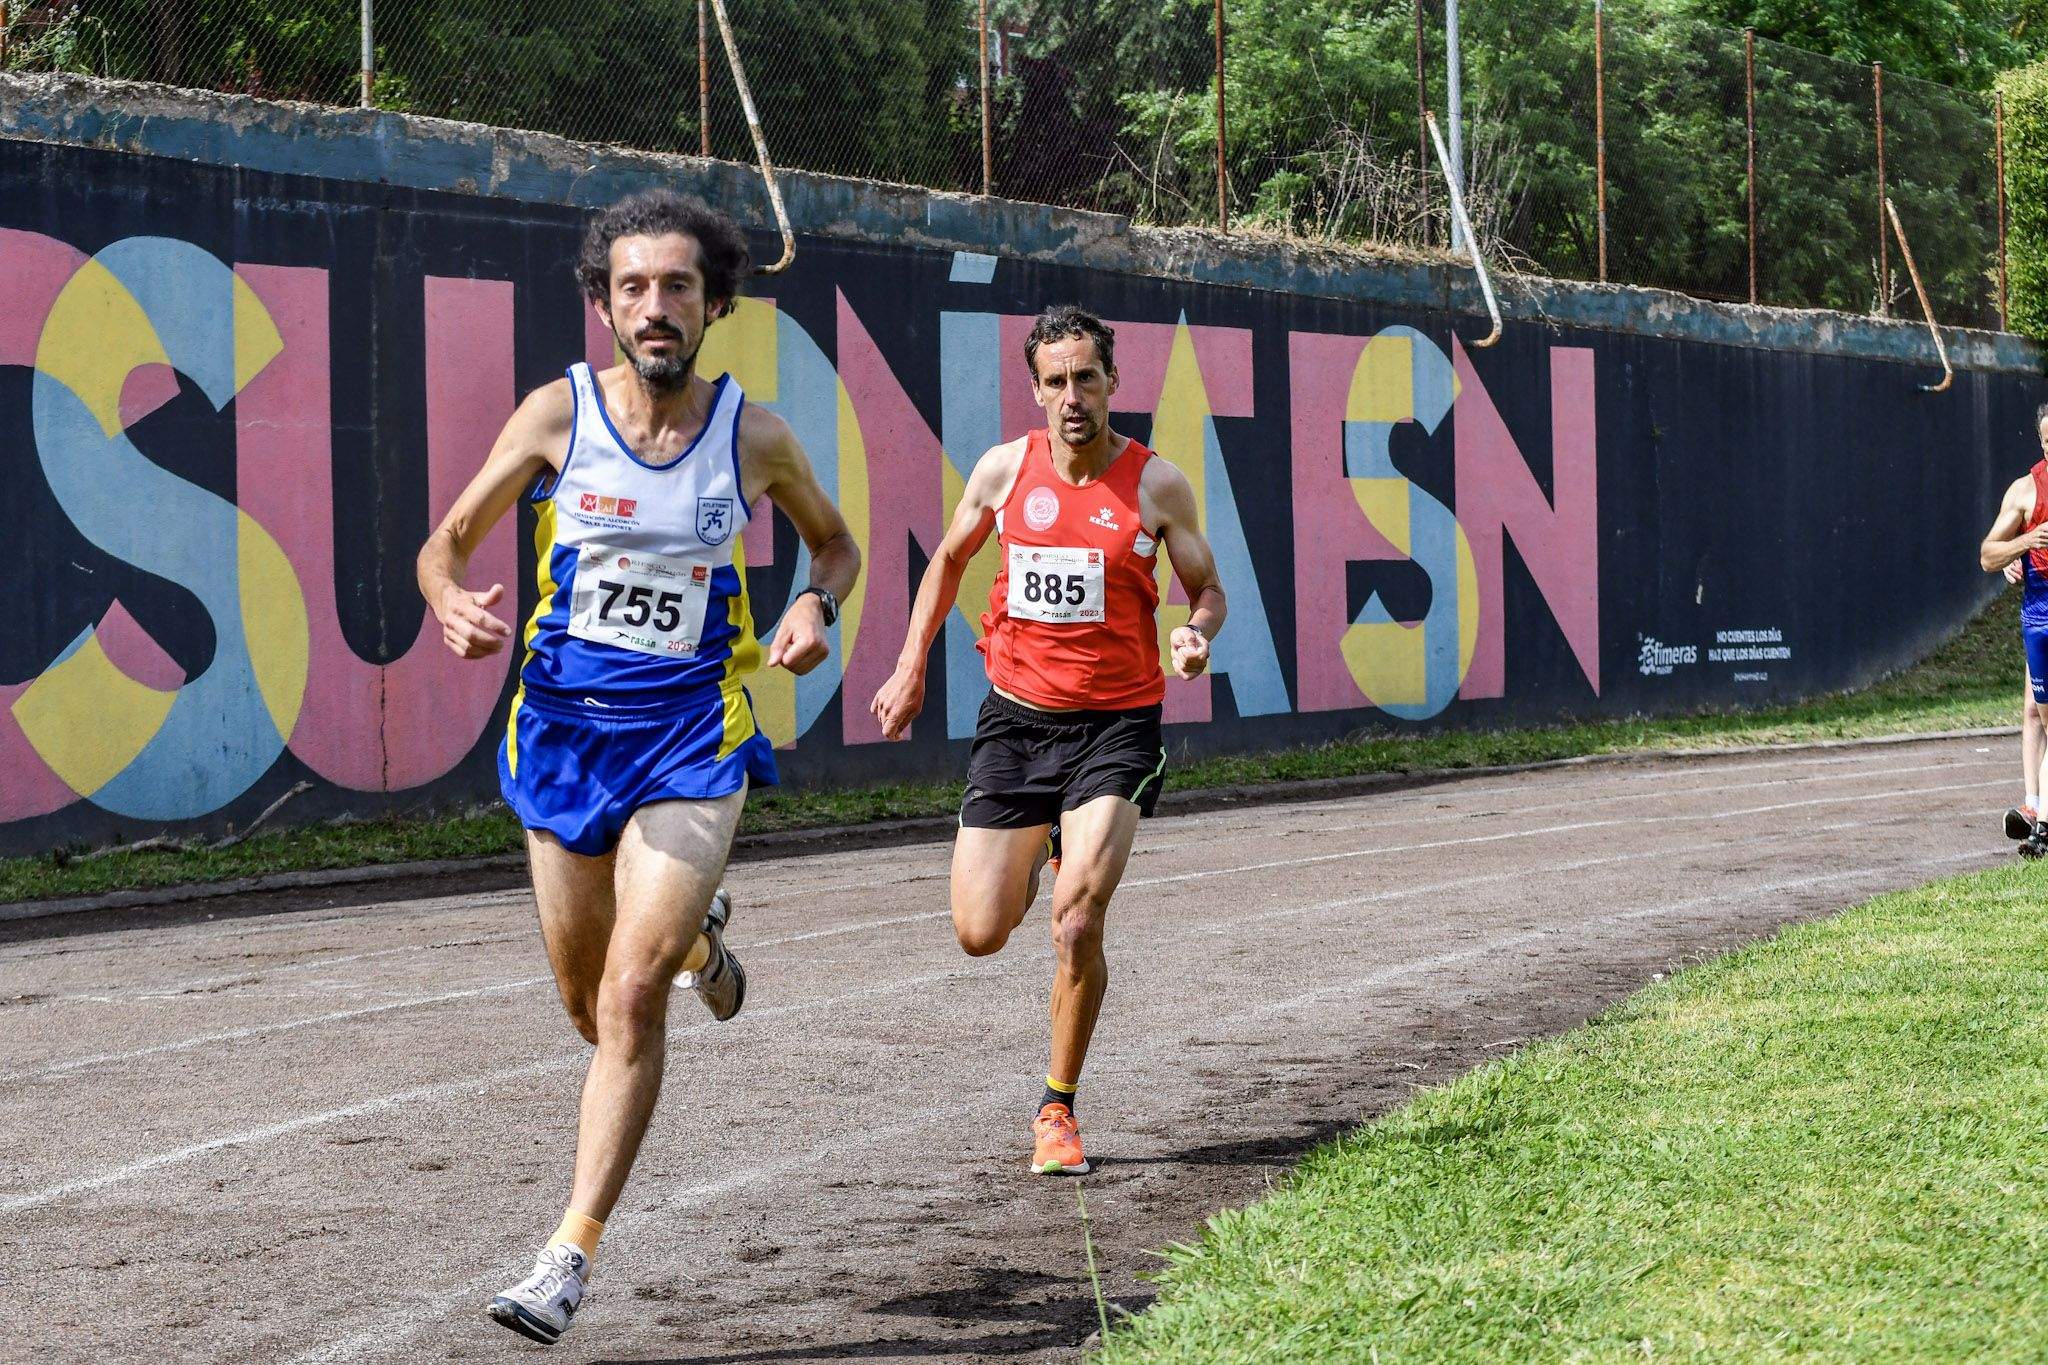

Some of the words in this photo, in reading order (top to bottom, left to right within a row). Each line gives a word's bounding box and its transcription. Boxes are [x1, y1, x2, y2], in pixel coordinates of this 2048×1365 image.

[1088, 515, 1120, 531] KELME
[1023, 571, 1086, 606] 885
[597, 579, 684, 633] 755
[1079, 609, 1099, 617] 2023
[1716, 630, 1727, 643] NO
[1755, 630, 1768, 642] LOS
[667, 640, 692, 652] 2023
[1736, 648, 1749, 661] LOS
